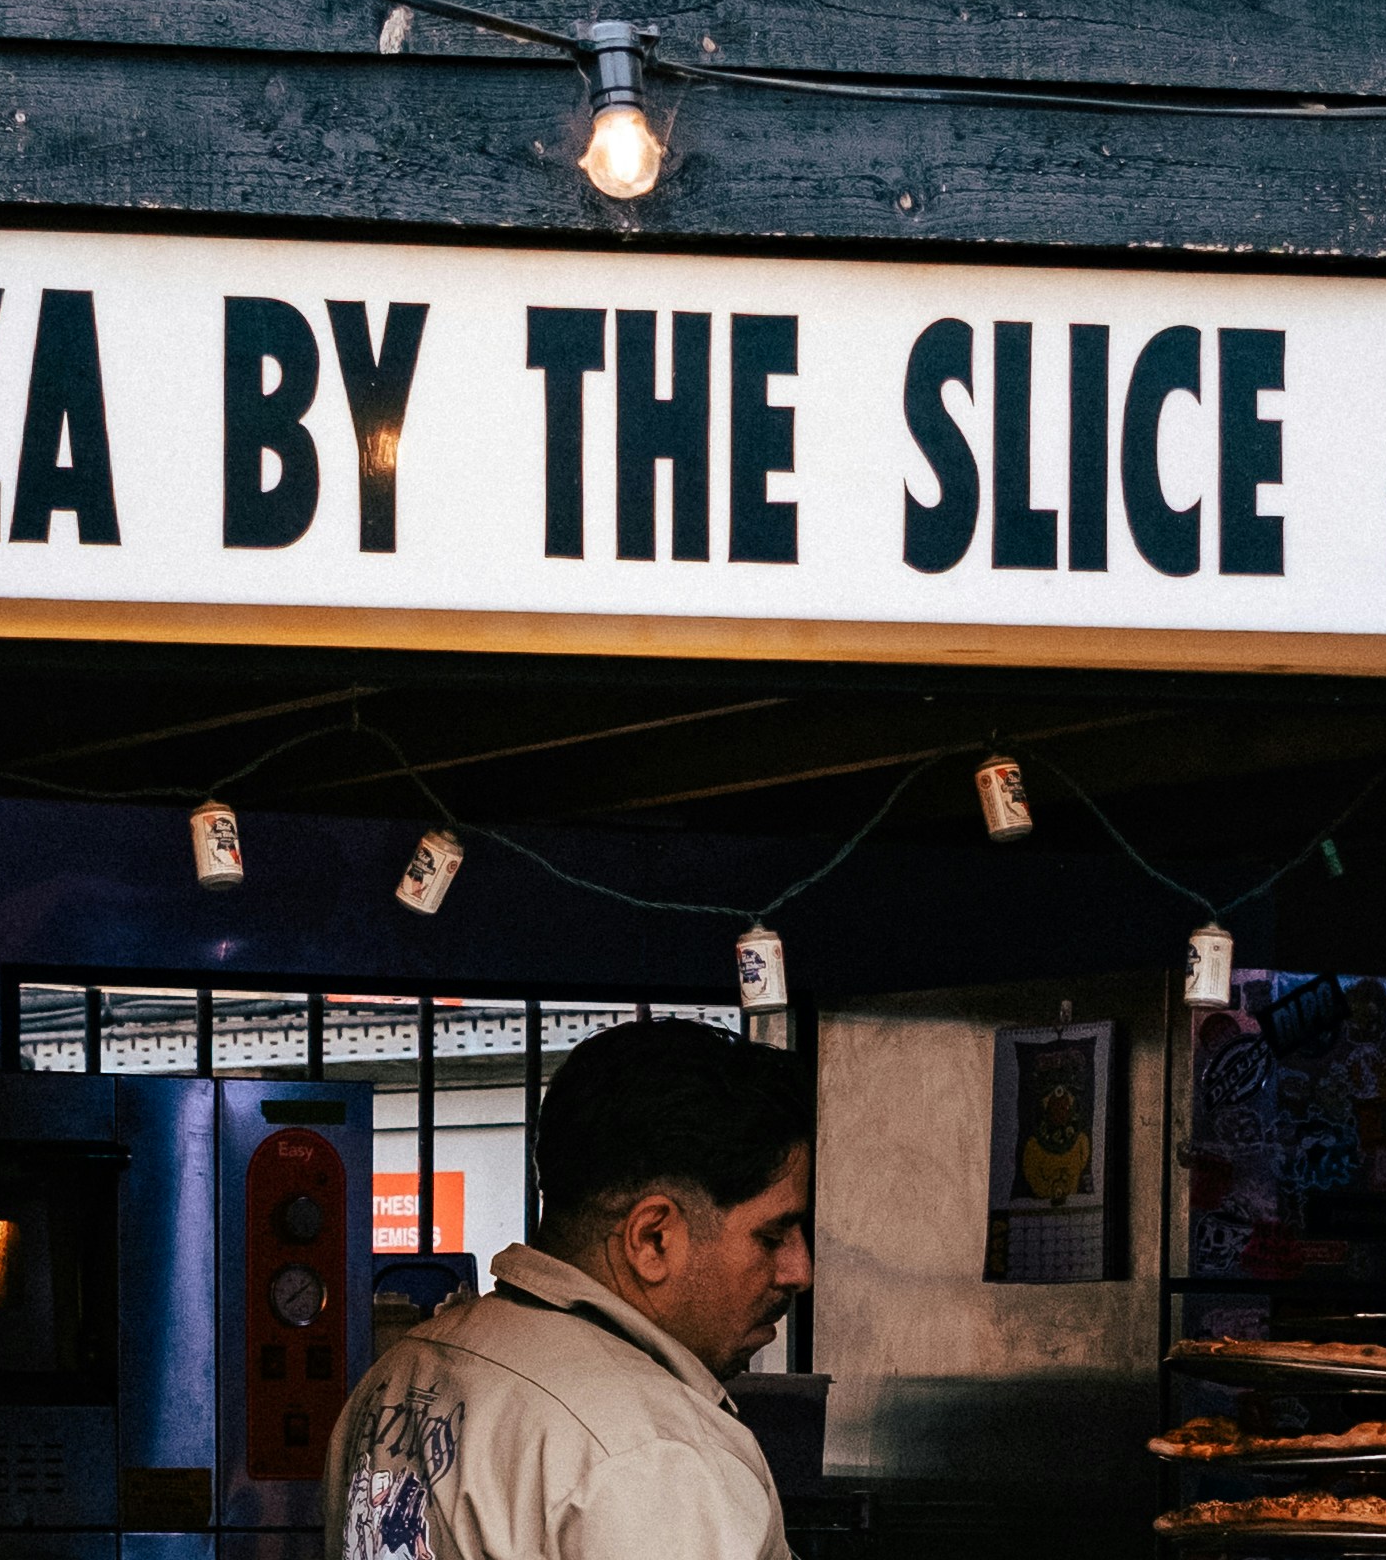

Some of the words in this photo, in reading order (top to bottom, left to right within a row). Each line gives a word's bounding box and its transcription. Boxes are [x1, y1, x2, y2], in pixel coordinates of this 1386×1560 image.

[224, 296, 429, 552] BY
[527, 306, 798, 564] THE
[904, 318, 1285, 577] SLICE
[278, 1141, 314, 1161] Easy
